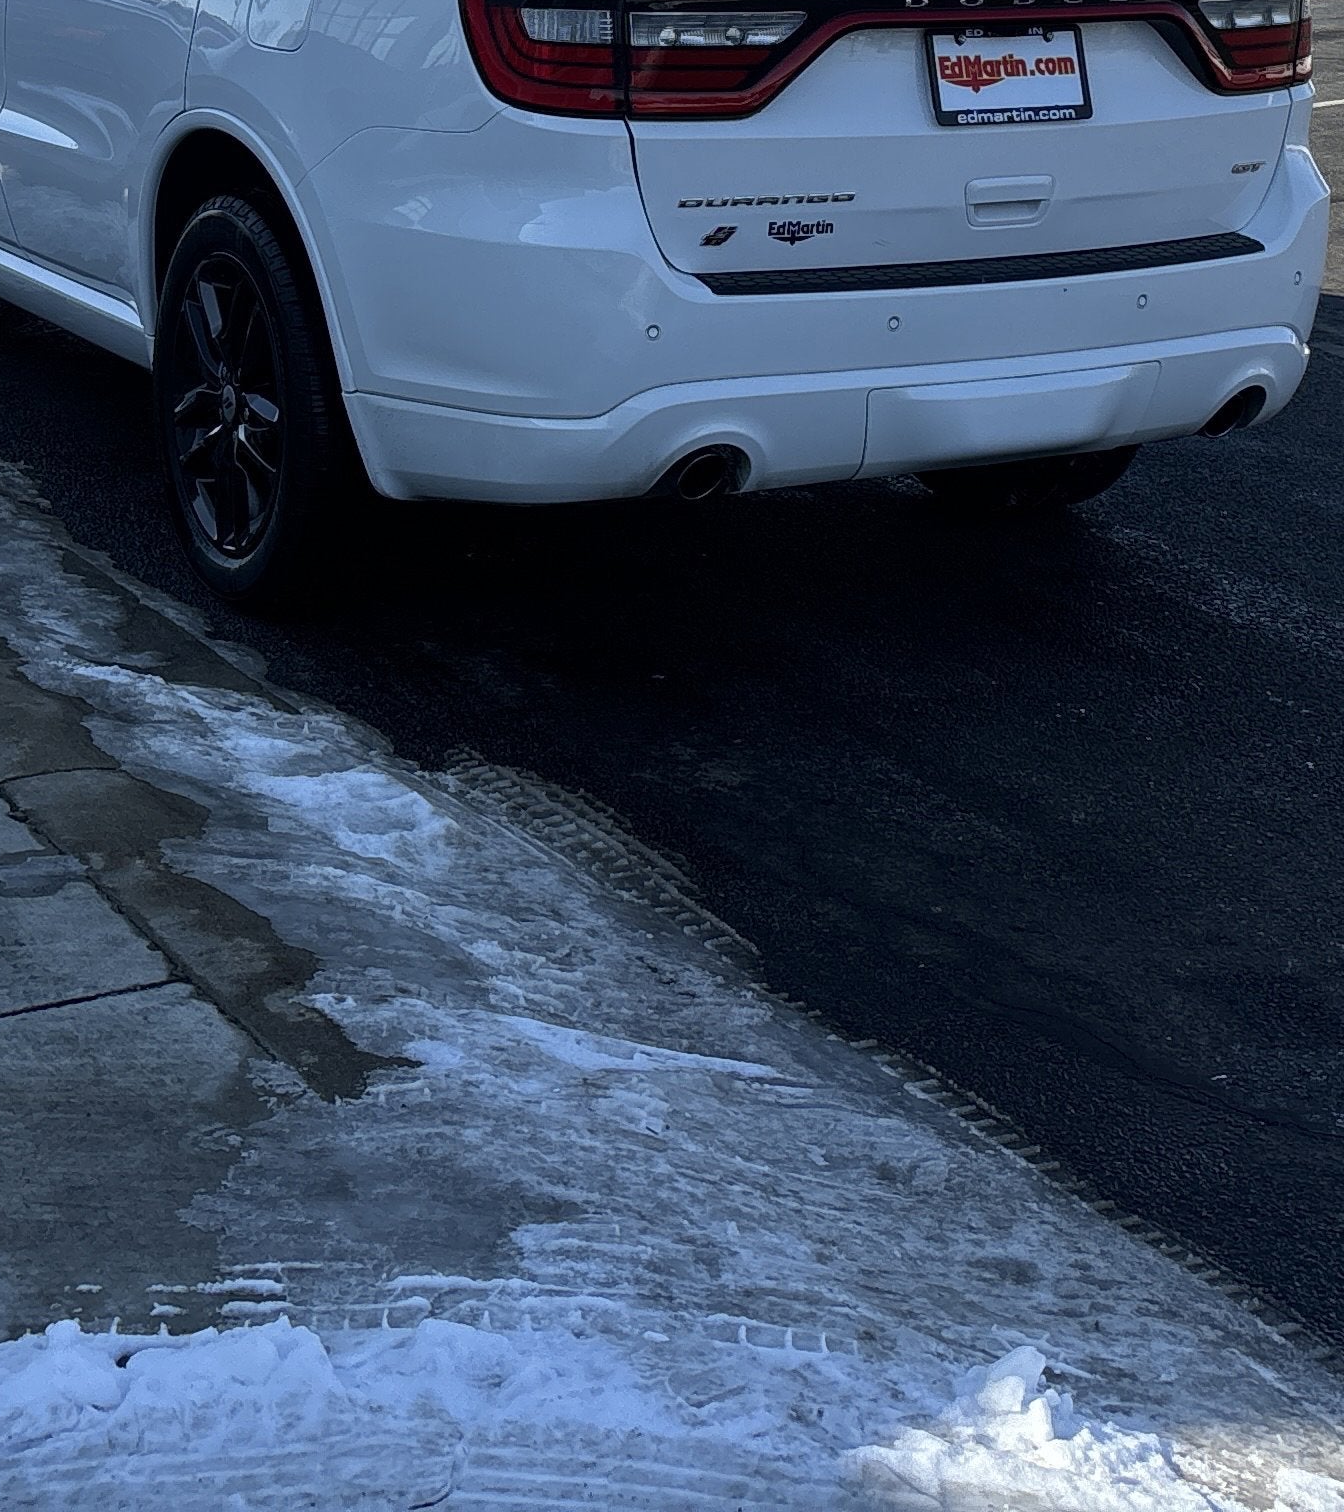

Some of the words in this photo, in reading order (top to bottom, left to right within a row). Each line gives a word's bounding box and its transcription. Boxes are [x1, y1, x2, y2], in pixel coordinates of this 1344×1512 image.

[938, 53, 1076, 82] EdMartin.com
[957, 107, 1076, 125] edmartin.com
[678, 191, 857, 209] DURANGO
[768, 219, 834, 237] EdMartin
